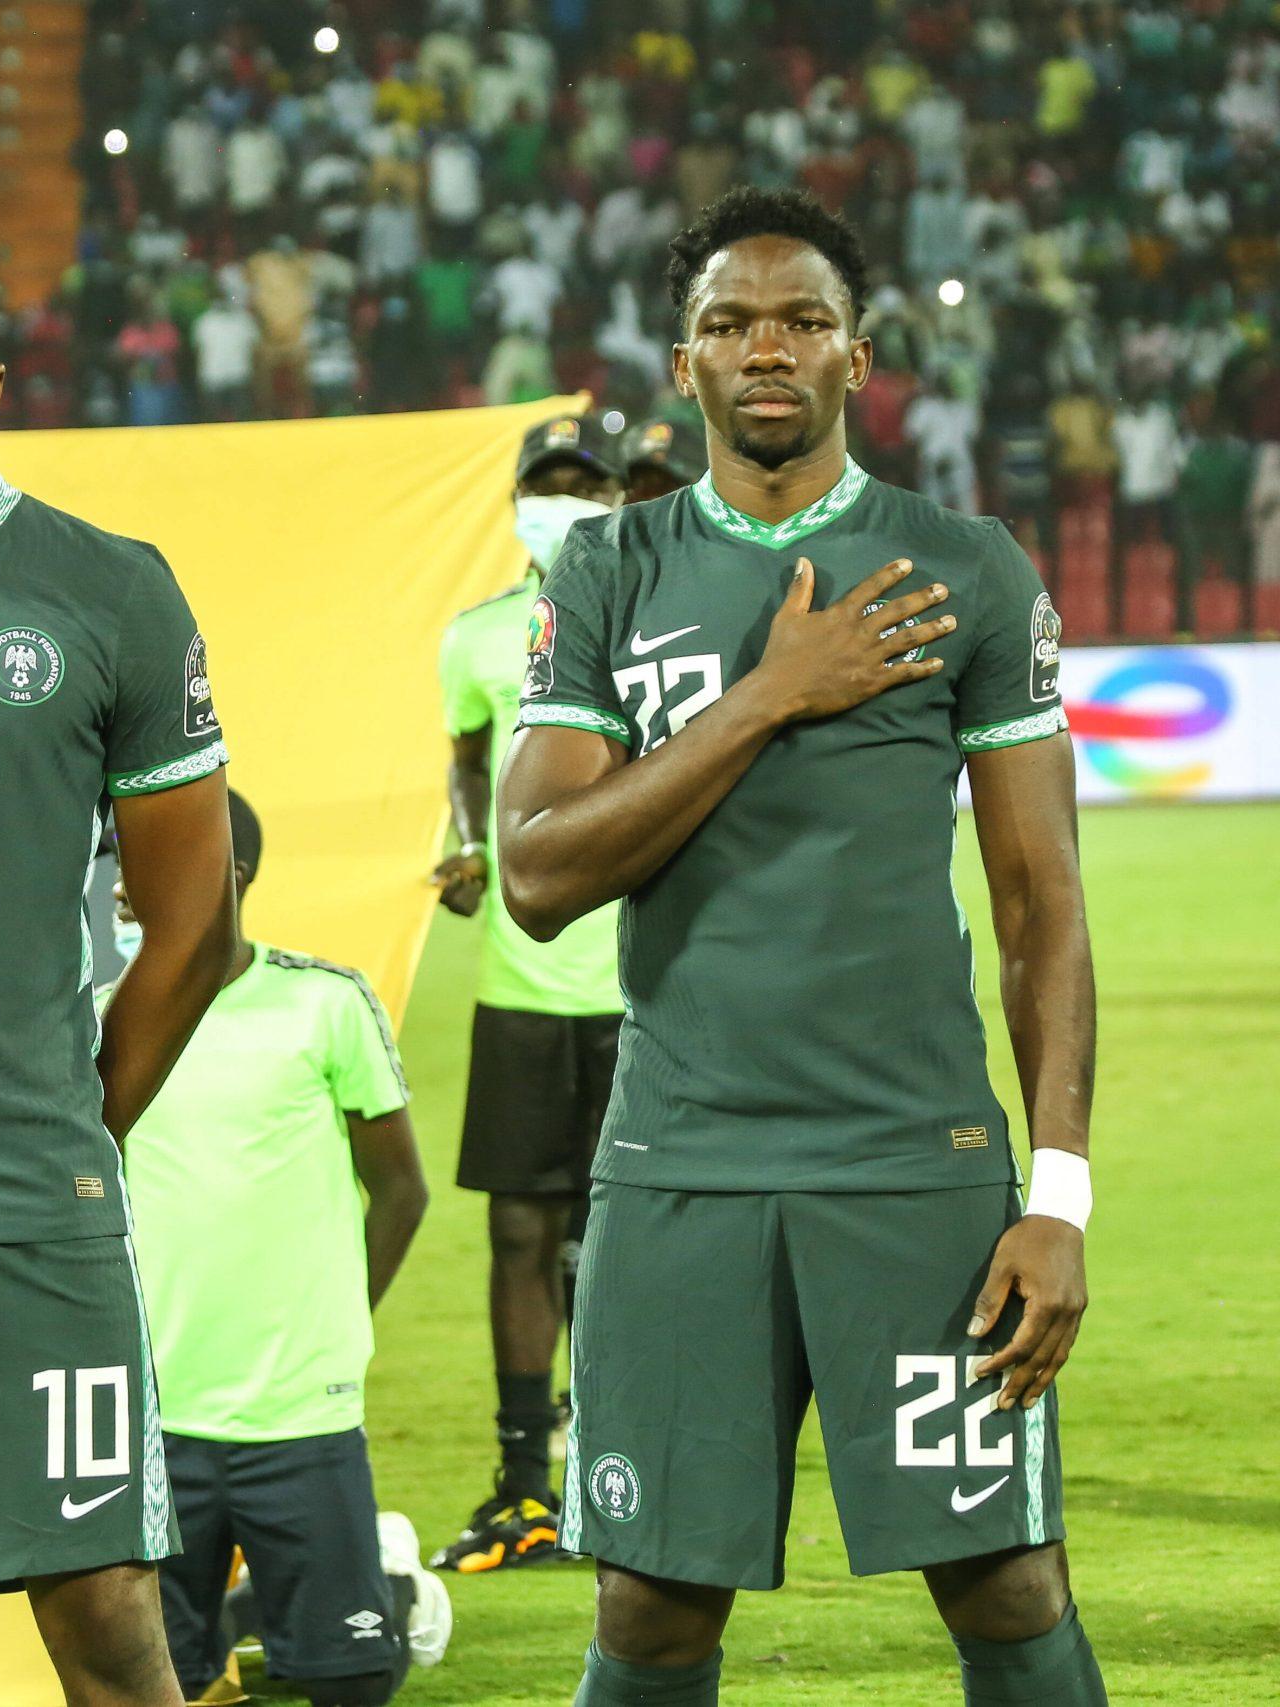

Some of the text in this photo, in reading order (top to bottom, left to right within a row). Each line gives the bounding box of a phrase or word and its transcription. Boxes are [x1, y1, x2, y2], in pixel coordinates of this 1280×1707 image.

[38, 637, 59, 694] FEDERATION
[10, 691, 31, 701] 1945
[196, 710, 216, 725] CA
[32, 1365, 131, 1480] 10
[895, 1355, 1013, 1467] 22
